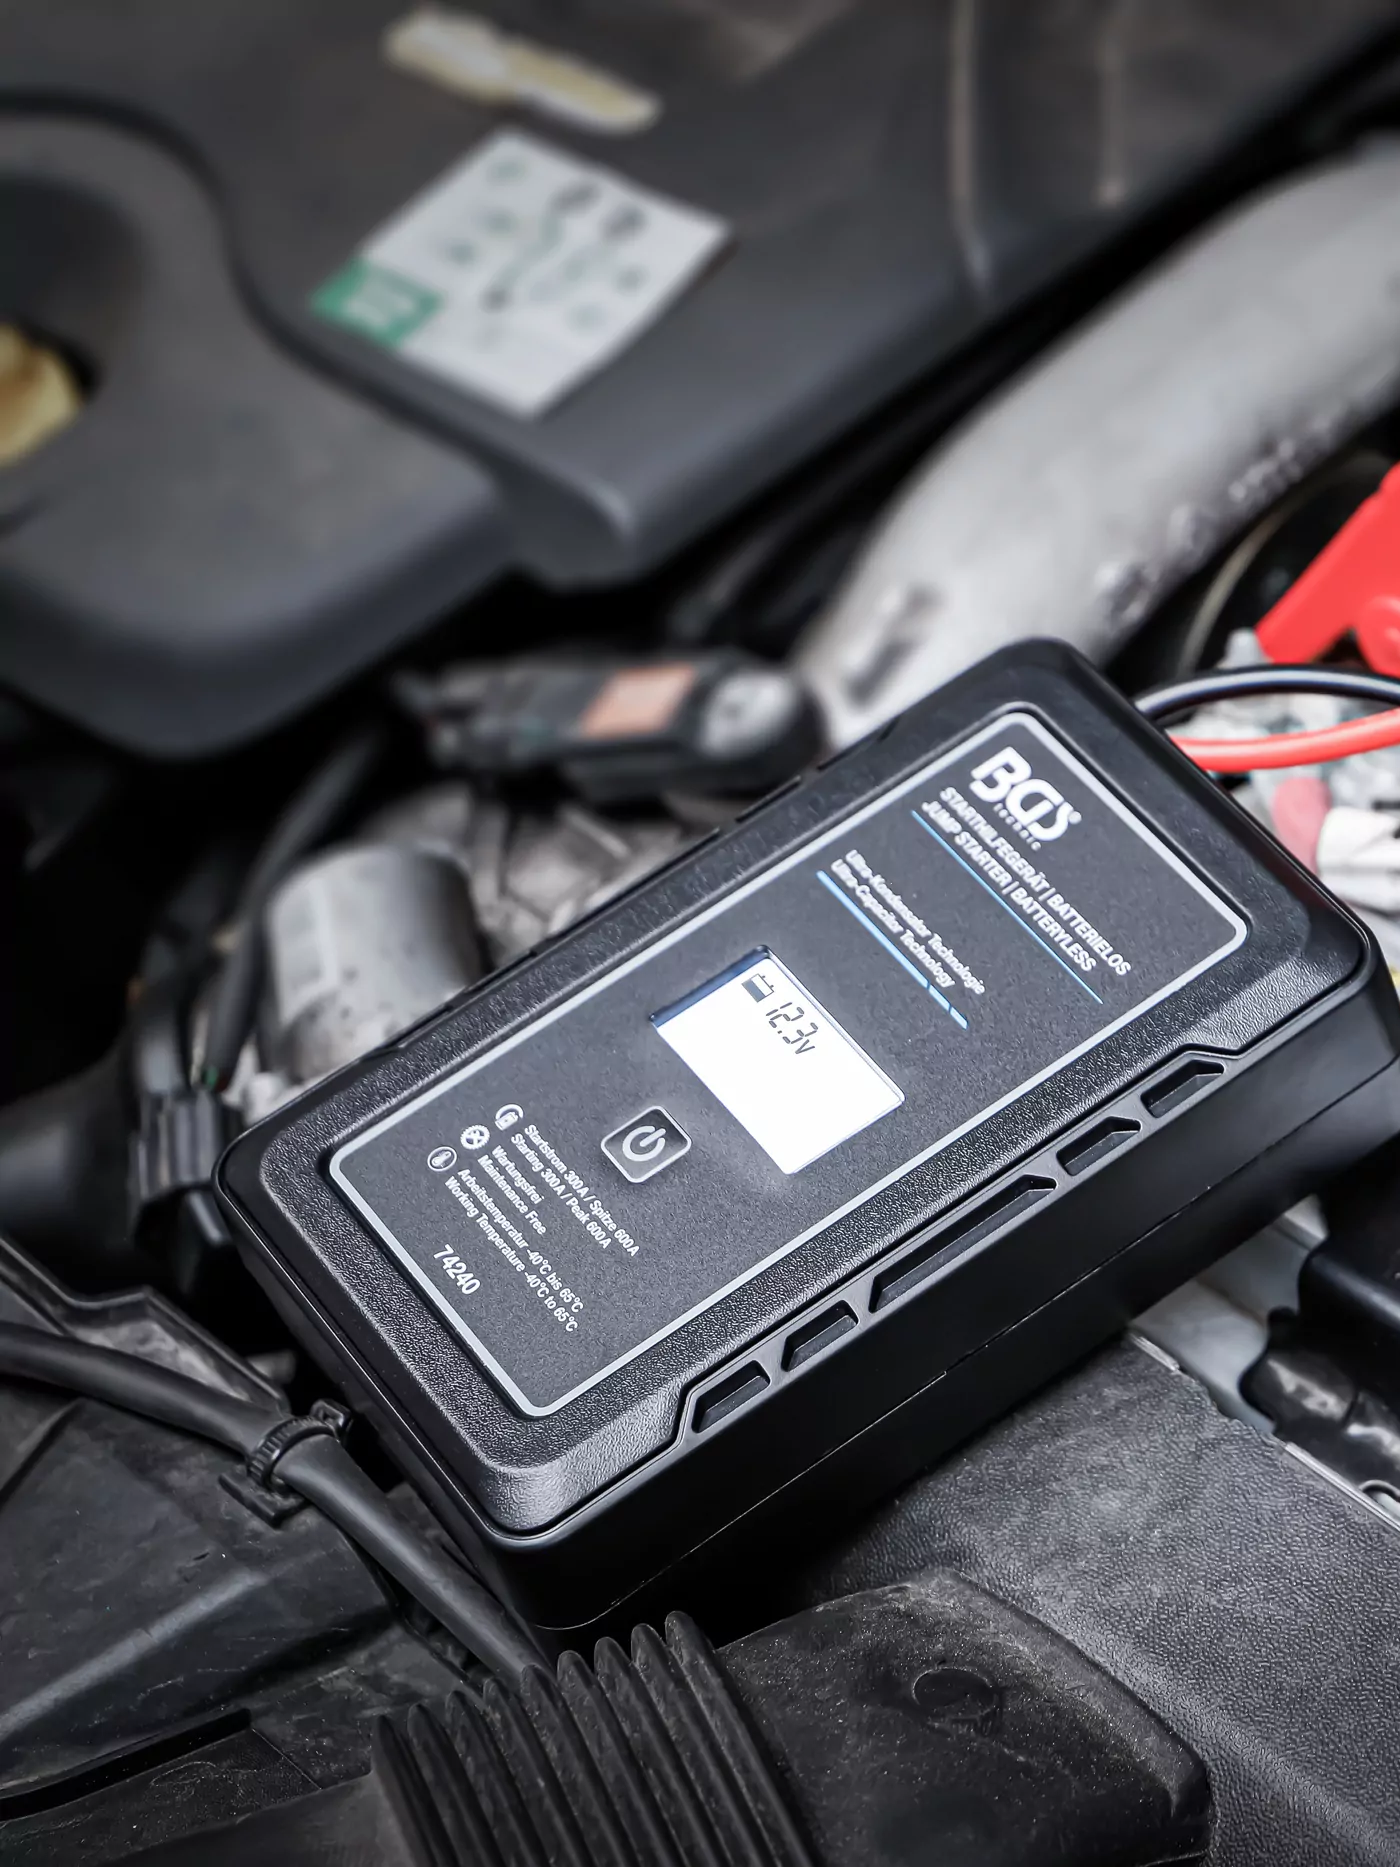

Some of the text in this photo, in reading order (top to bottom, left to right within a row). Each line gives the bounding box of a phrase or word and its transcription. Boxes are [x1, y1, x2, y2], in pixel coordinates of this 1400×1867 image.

[922, 801, 963, 838] JUMP
[955, 832, 1018, 893] STARTER
[1011, 888, 1096, 971] BATTERYLESS
[940, 787, 1050, 897] STARTHILFEGERÄT
[1047, 894, 1131, 975] BATTERIELOS
[994, 803, 1041, 850] technic
[831, 859, 955, 987] Ultra-Capacitor Technology
[846, 850, 985, 994] Ultra-Kondensator Technologie
[456, 1169, 529, 1248] Arbeitstemperatur
[546, 1272, 562, 1290] bis
[478, 1155, 546, 1235] Maintenance Free
[492, 1145, 544, 1204] Wartungsfrei
[511, 1134, 544, 1172] Starting
[541, 1169, 565, 1195] 300A
[566, 1197, 590, 1224] Peak
[586, 1222, 611, 1249] 600A
[525, 1125, 567, 1173] Startstrom
[564, 1171, 589, 1197] 300A
[588, 1200, 616, 1235] Spitze
[614, 1229, 639, 1256] 600A
[434, 1244, 480, 1294] 74240
[445, 1176, 479, 1217] Working
[476, 1213, 525, 1271] Temperature
[544, 1296, 556, 1309] to
